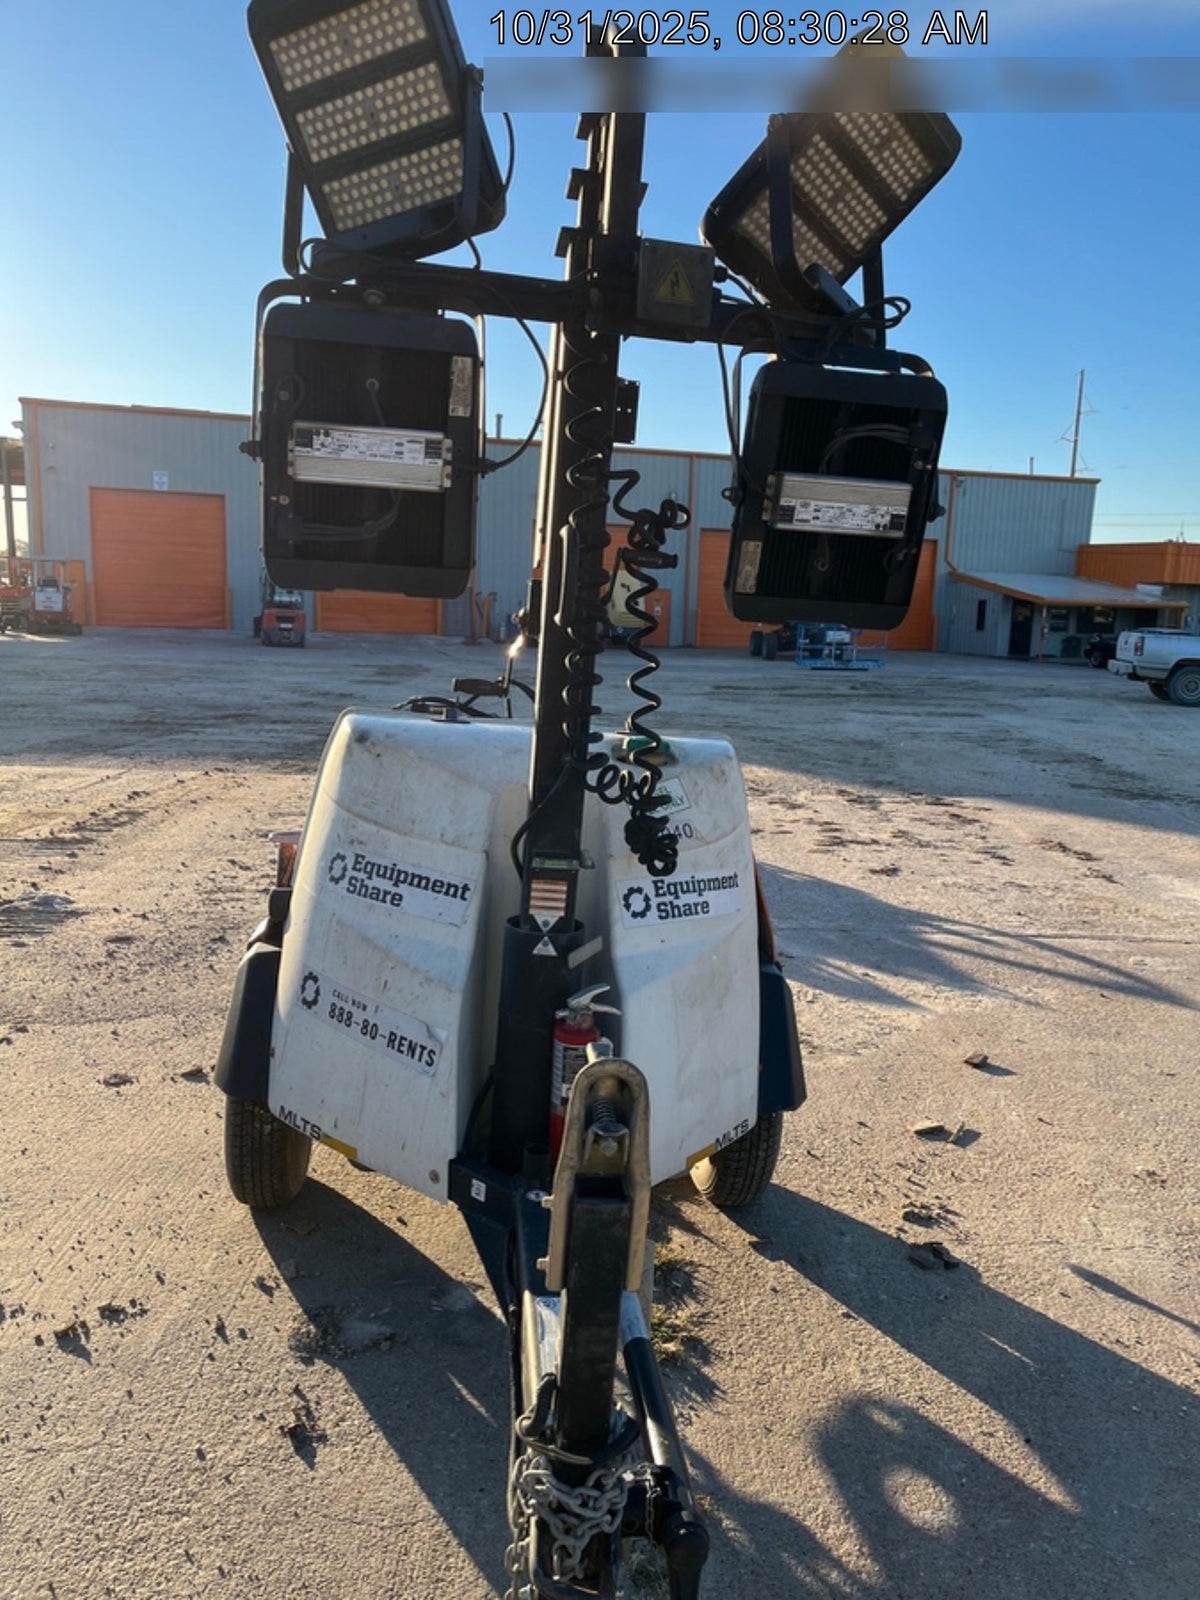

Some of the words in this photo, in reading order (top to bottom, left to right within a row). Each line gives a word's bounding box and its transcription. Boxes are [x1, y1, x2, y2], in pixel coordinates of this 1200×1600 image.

[346, 875, 404, 908] Share
[351, 852, 471, 902] Equipment
[652, 871, 739, 900] Equipment
[656, 900, 710, 920] Share
[328, 1001, 437, 1068] 888-80-RENTS
[279, 1104, 322, 1140] MLTS
[715, 1117, 749, 1150] MLTS
